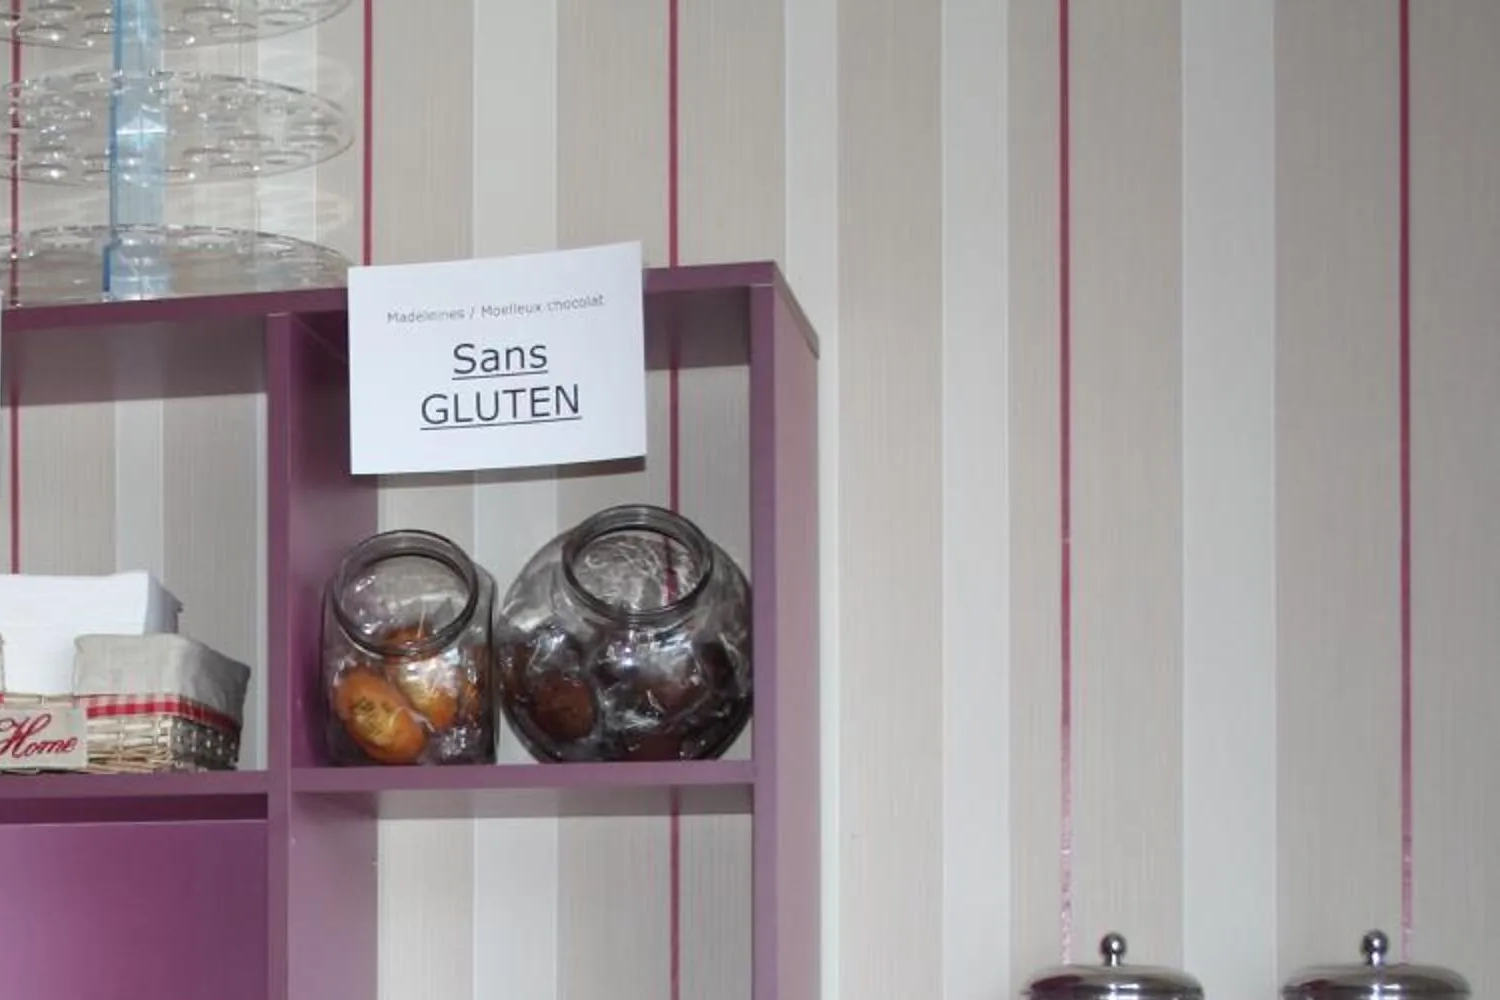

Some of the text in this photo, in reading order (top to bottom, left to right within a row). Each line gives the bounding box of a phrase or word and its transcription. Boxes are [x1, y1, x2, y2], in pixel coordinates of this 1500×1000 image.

[481, 303, 543, 317] Moelleux
[547, 294, 605, 311] chocolat
[453, 342, 548, 375] Sans
[420, 384, 581, 425] GLUTEN
